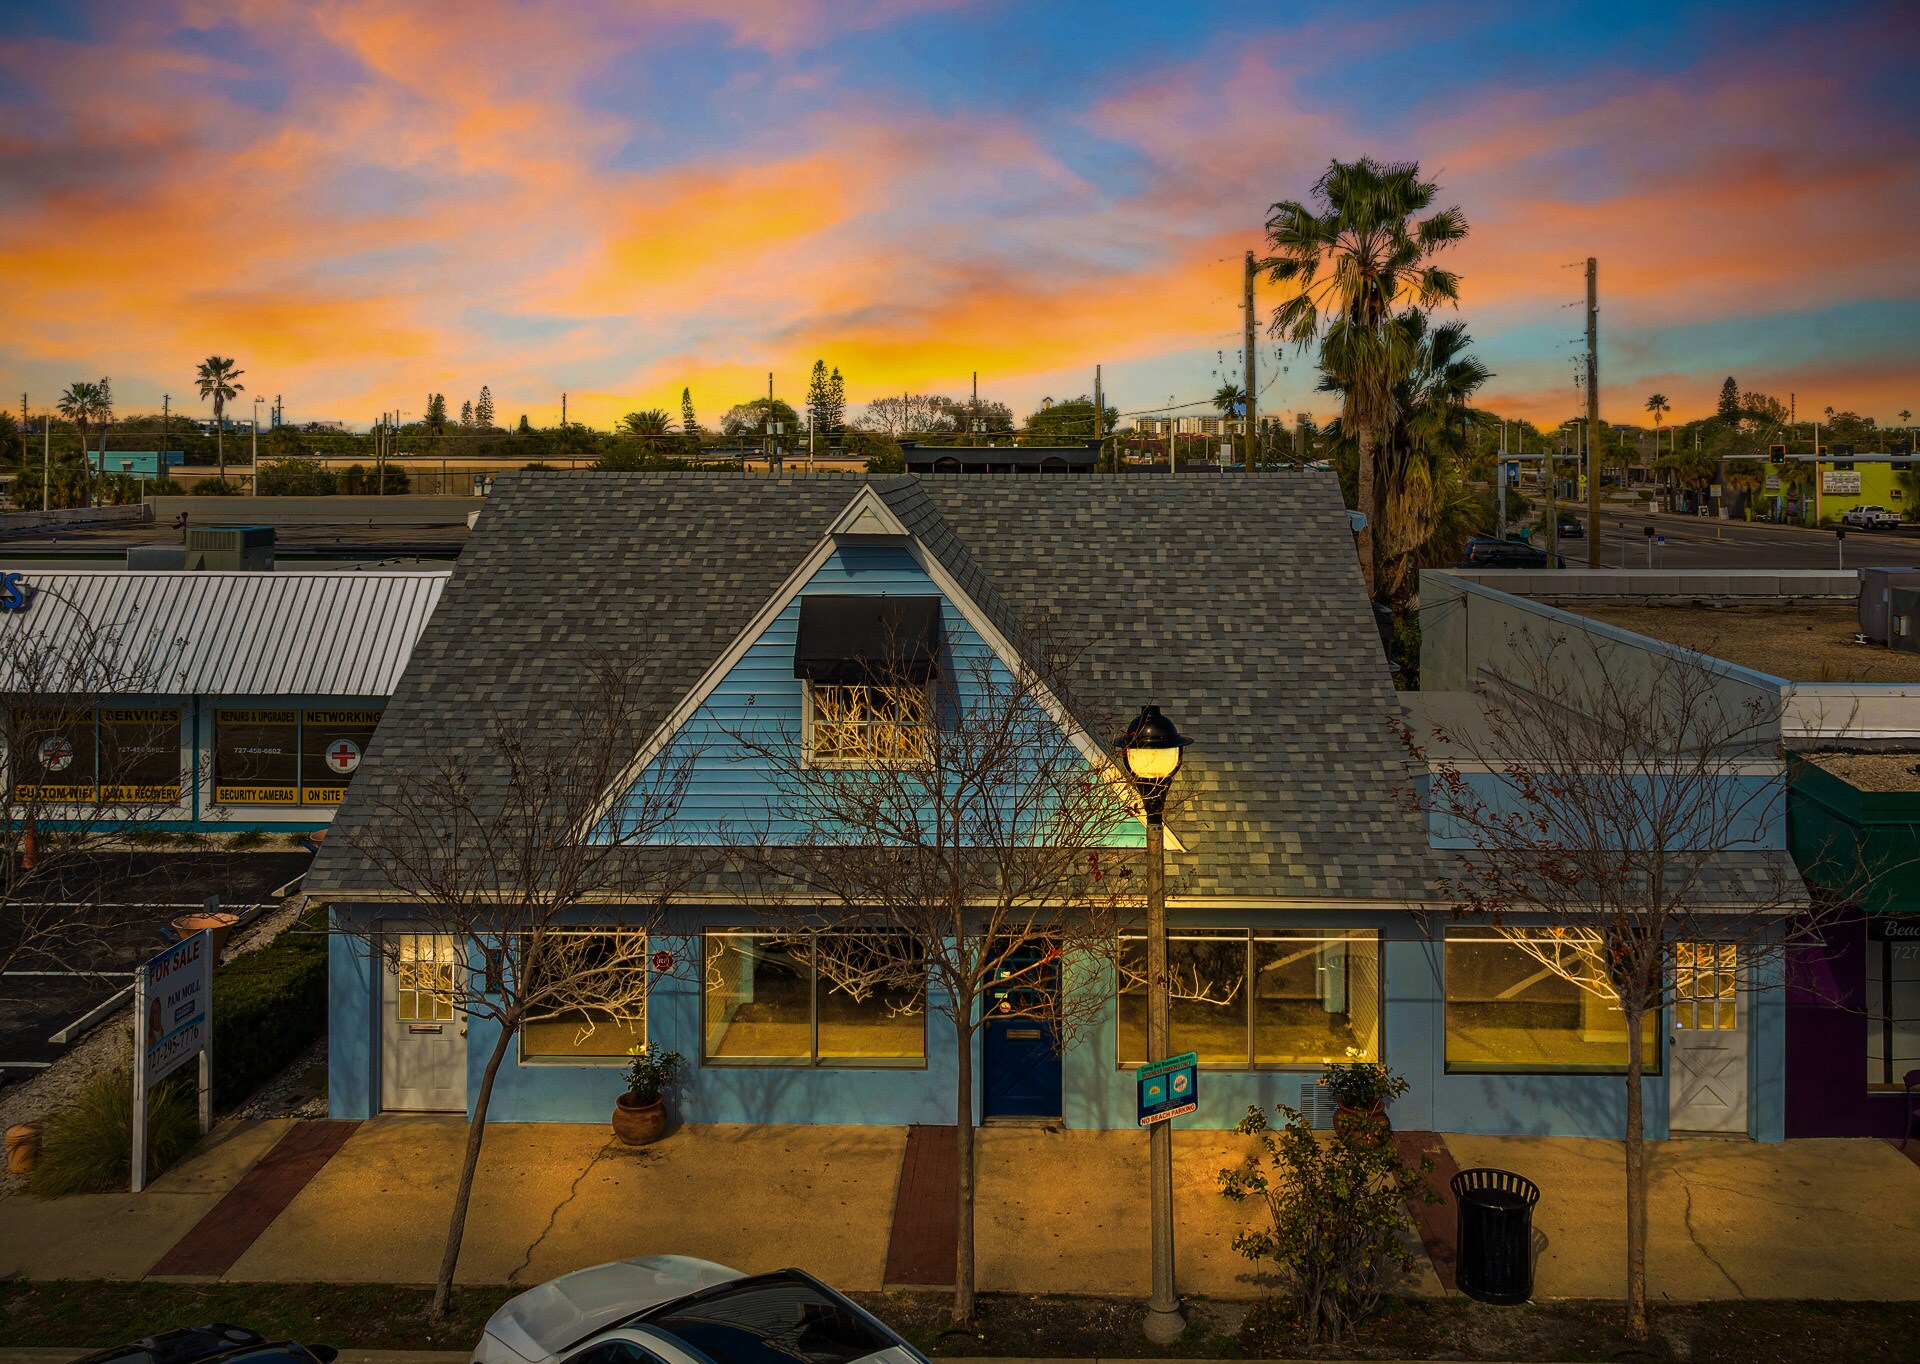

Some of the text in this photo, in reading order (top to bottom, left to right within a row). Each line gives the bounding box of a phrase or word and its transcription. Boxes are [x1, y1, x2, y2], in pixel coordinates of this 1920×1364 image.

[0, 572, 22, 609] S
[105, 710, 179, 721] SERVICES
[221, 711, 295, 722] REPAIRS & UPGRADES
[307, 711, 381, 722] NETWORKING
[135, 788, 177, 799] RECOVERY
[220, 789, 294, 800] SECURITY CAMERAS
[308, 790, 320, 801] ON
[322, 790, 341, 801] SITE
[149, 939, 200, 986] FOR SALE
[167, 980, 200, 1008] PAM MOLL
[1141, 1117, 1150, 1125] NO
[1151, 1111, 1170, 1122] BEACH
[1172, 1103, 1195, 1116] PARKING
